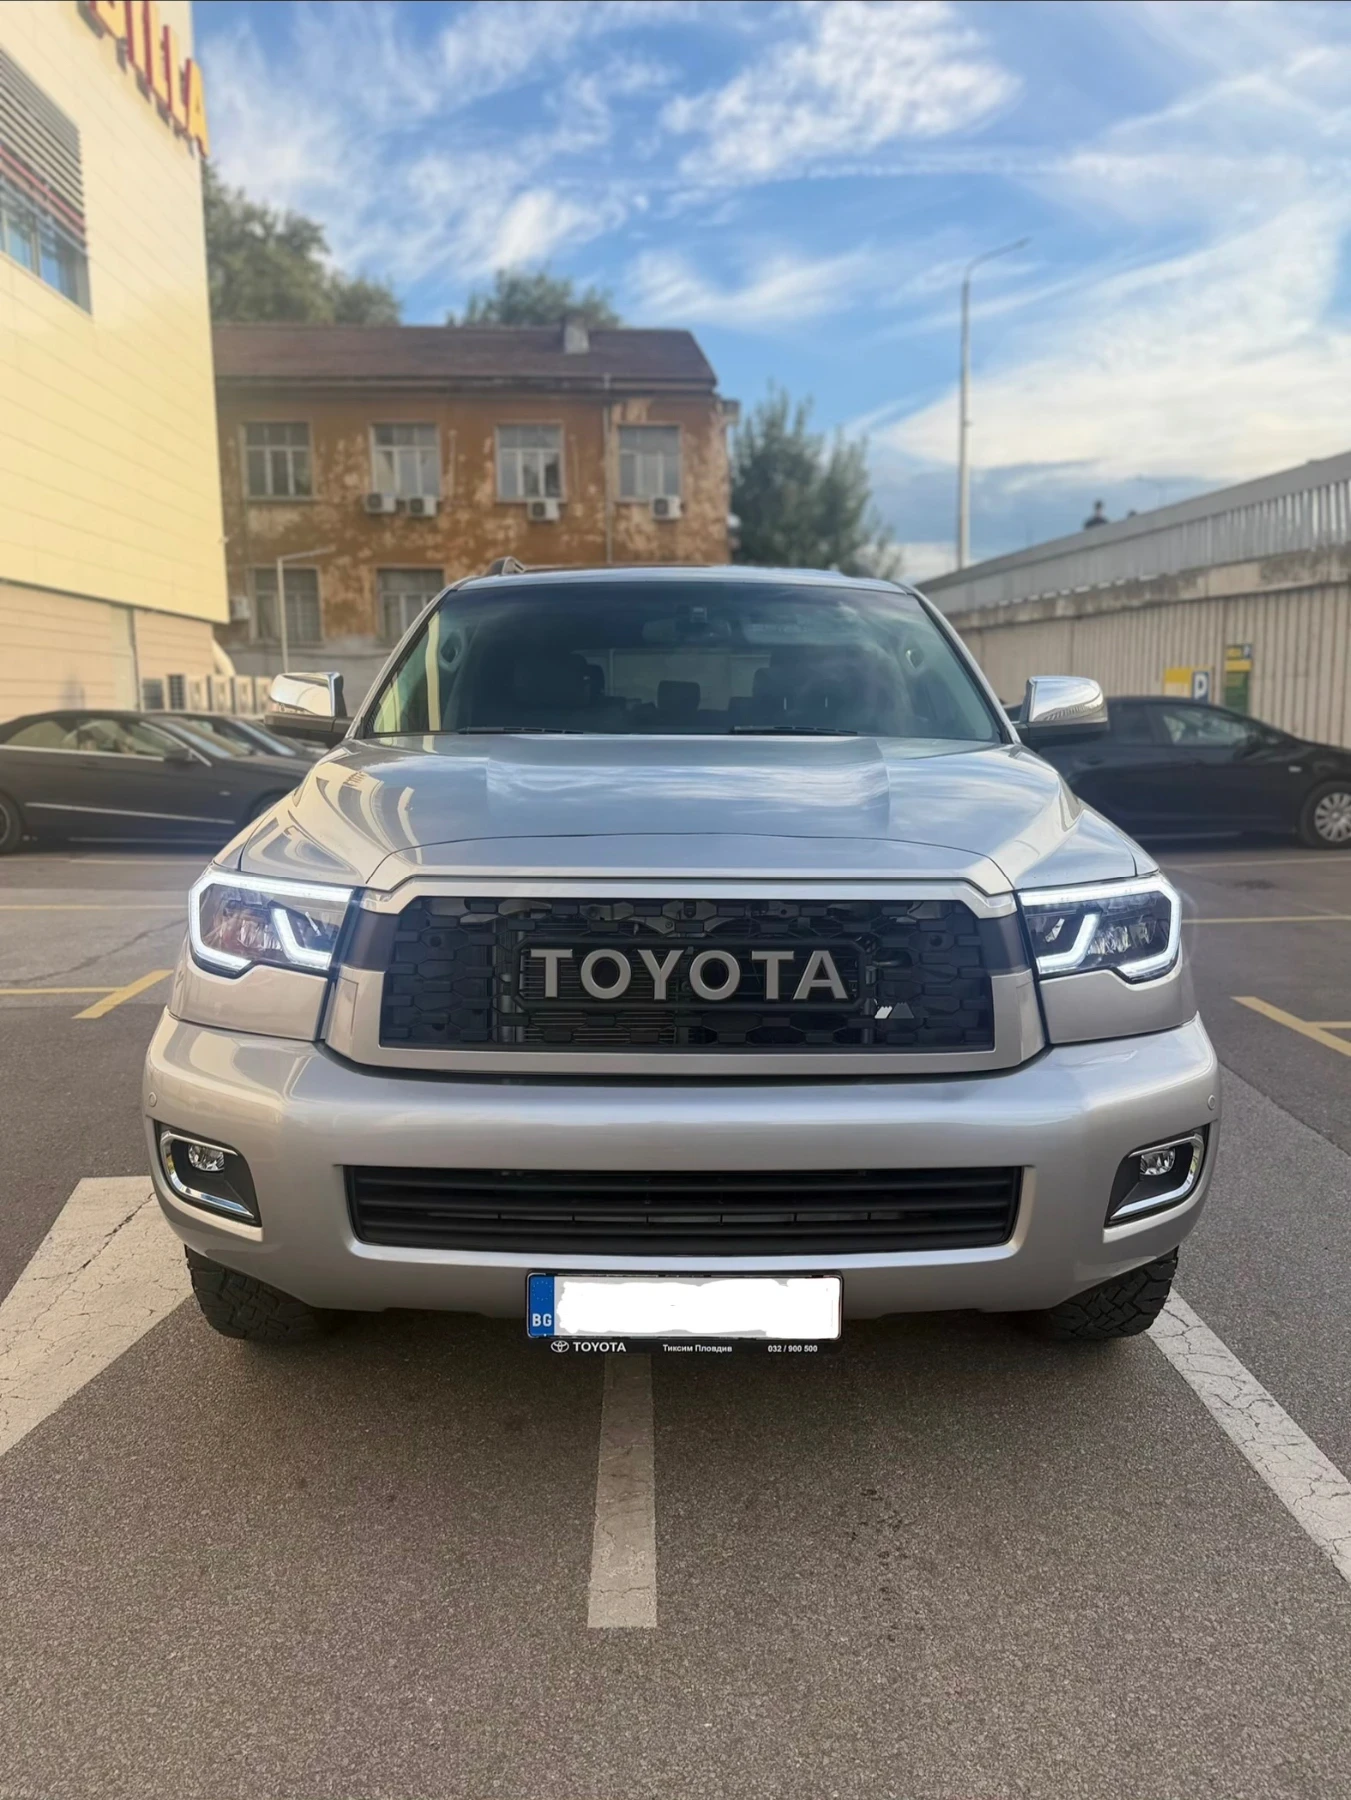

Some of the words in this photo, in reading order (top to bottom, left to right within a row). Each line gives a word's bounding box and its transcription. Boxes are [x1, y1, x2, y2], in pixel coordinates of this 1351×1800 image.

[1193, 673, 1208, 700] P
[529, 948, 849, 1001] TOYOTA
[532, 1313, 552, 1327] BG
[572, 1341, 627, 1352] TOYOTA
[662, 1344, 693, 1352] Тиксим
[695, 1344, 733, 1354] Пловдив
[767, 1344, 783, 1353] 032
[788, 1344, 803, 1353] 900
[803, 1344, 819, 1353] 500
